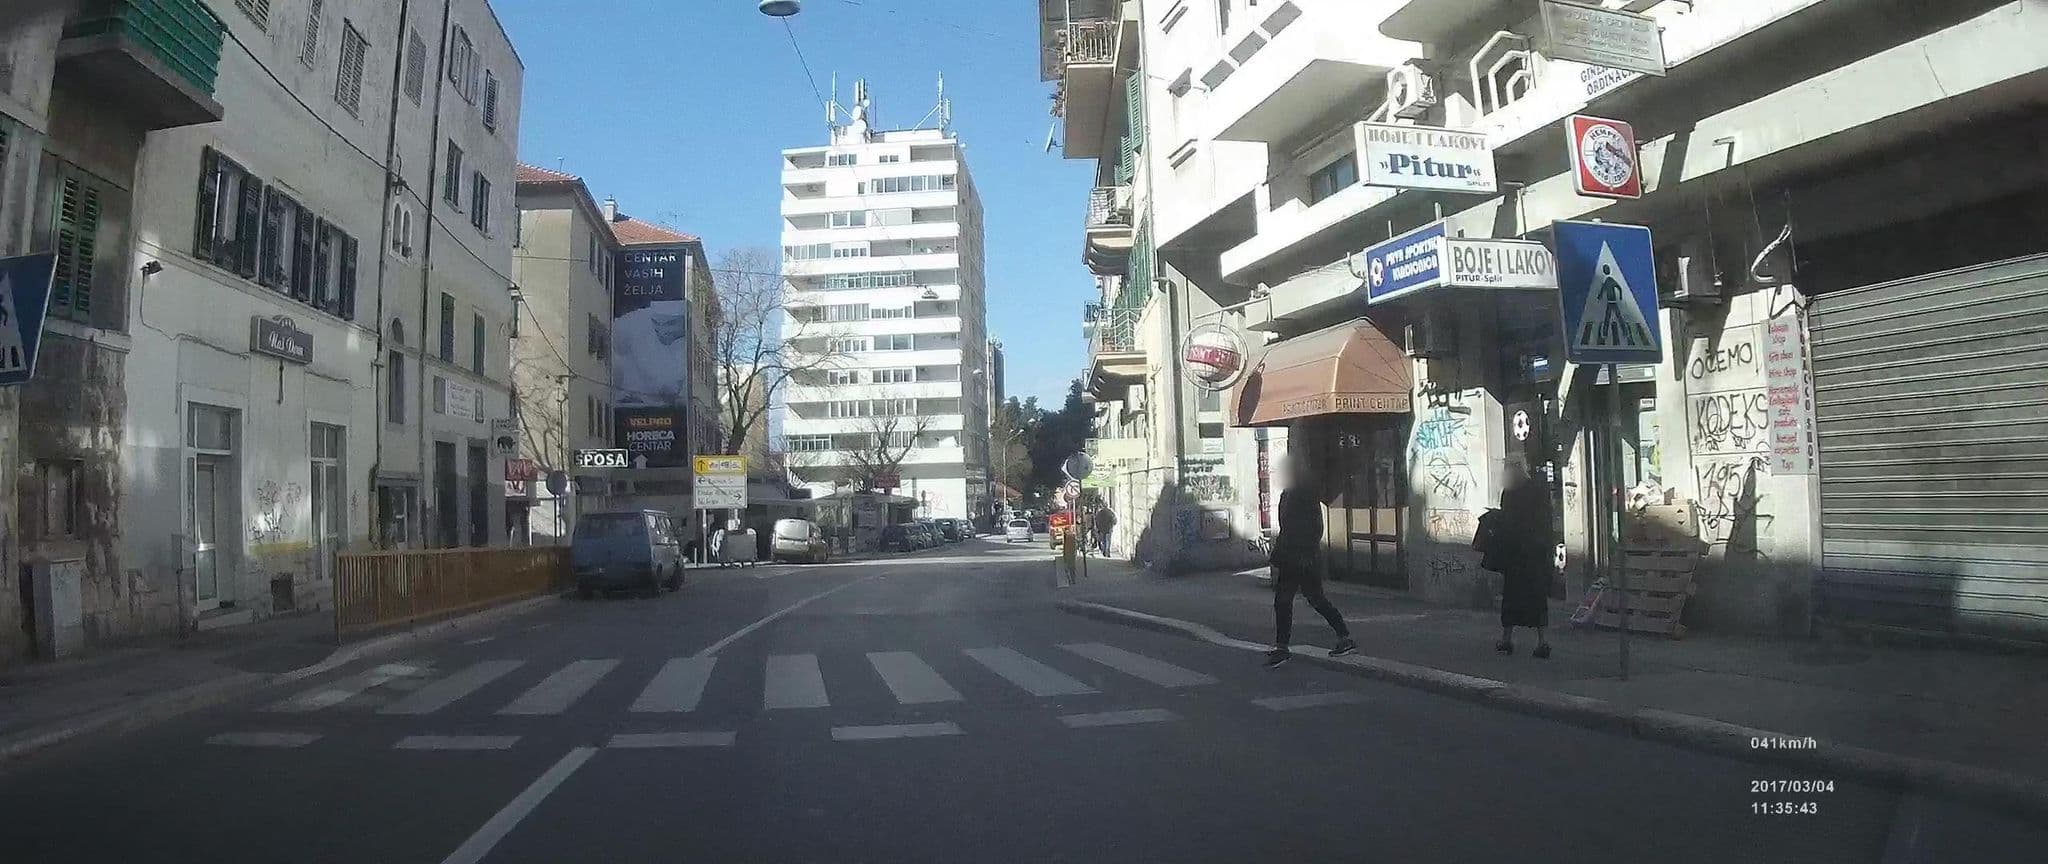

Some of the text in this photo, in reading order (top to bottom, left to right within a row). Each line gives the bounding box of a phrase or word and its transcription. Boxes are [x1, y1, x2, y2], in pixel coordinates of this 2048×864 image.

[624, 251, 677, 263] CENTAR
[1454, 246, 1493, 275] BOJE
[1497, 248, 1503, 274] I
[1335, 398, 1367, 409] PRINT
[1696, 393, 1769, 440] KODEKS
[627, 430, 676, 441] HORECA
[629, 440, 672, 452] CENTAR
[575, 452, 626, 467] SPOSA
